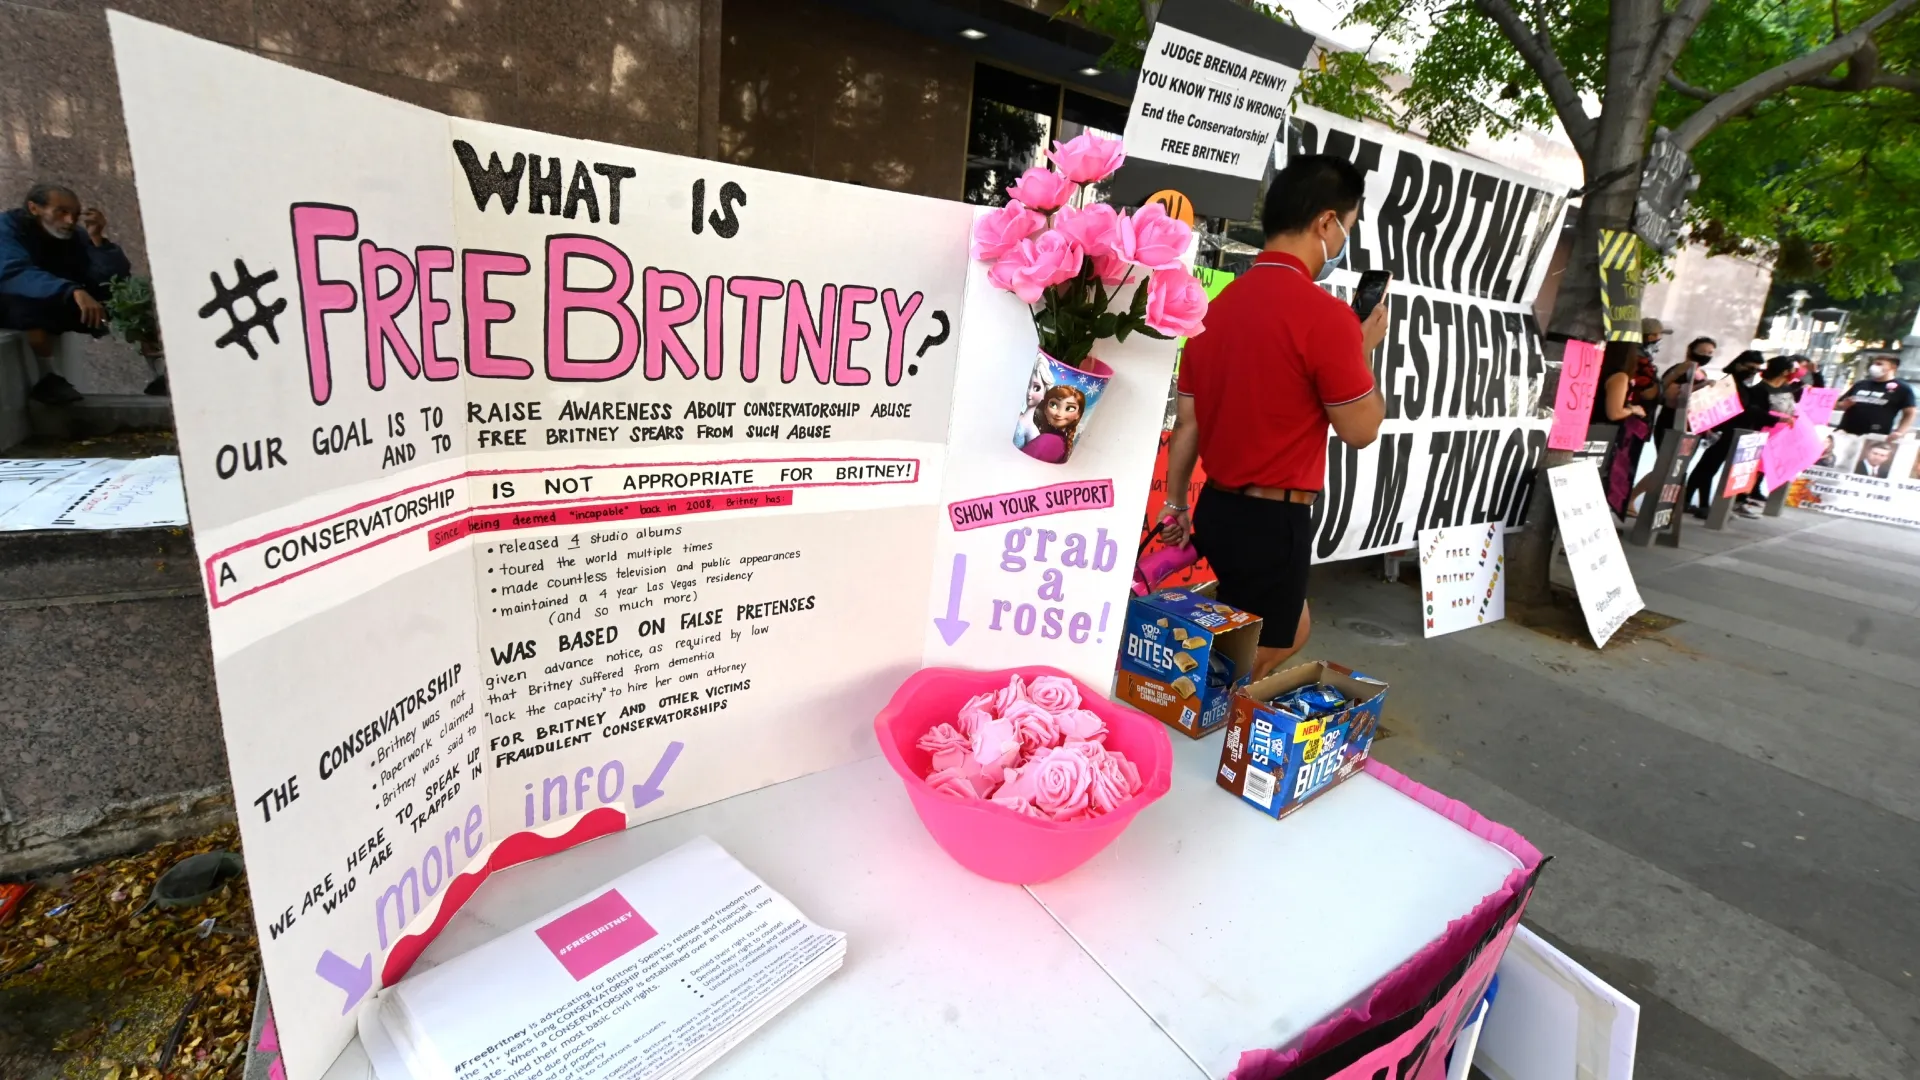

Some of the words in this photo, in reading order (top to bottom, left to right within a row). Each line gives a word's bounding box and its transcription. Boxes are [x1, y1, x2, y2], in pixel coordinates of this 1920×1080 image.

[1161, 42, 1203, 66] JUDGE
[1204, 55, 1247, 80] BRENDA
[1249, 69, 1287, 92] PENNY!
[1142, 69, 1168, 88] YOU
[1169, 77, 1206, 98] KNOW
[1208, 88, 1232, 106] THIS
[1233, 95, 1244, 109] IS
[1246, 98, 1286, 120] WRONG!
[1141, 102, 1164, 120] End
[1166, 110, 1185, 125] the
[1187, 114, 1269, 146] Conservatorship!
[1161, 138, 1190, 156] FREE
[1192, 144, 1240, 165] BRITNEY!
[453, 139, 636, 224] WHAT
[692, 179, 747, 238] IS
[216, 437, 287, 479] OUR
[312, 418, 373, 456] GOAL
[389, 412, 405, 438] IS
[421, 407, 443, 431] TO
[467, 401, 542, 424] RAISE
[558, 401, 672, 421] AWARENESS
[684, 401, 736, 419] ABOUT
[744, 401, 860, 418] CONSERVATORSHIP
[871, 402, 912, 418] ABUSE
[381, 443, 416, 470] AND
[432, 435, 451, 453] TO
[478, 428, 526, 449] FREE
[547, 426, 619, 444] BRITNEY
[629, 426, 683, 442] SPEARS
[697, 425, 733, 440] FROM
[746, 423, 779, 439] SUCH
[787, 425, 831, 439] ABUSE
[954, 504, 993, 525] SHOW
[1000, 495, 1039, 516] YOUR
[1045, 485, 1108, 508] SUPPORT
[1359, 433, 1413, 551] M.
[1413, 427, 1550, 540] TAYLOR
[220, 562, 237, 587] A
[264, 488, 455, 569] CONSERVATORSHIP
[492, 482, 515, 500] IS
[545, 477, 593, 495] NOT
[623, 469, 754, 491] APPROPRIATE
[781, 466, 813, 482] FOR
[836, 464, 912, 480] BRITNEY!
[500, 536, 559, 554] released
[590, 531, 628, 544] studio
[636, 526, 682, 540] albums
[500, 560, 544, 575] toured
[557, 556, 575, 568] the
[586, 552, 617, 565] world
[627, 546, 672, 559] multiple
[683, 541, 712, 553] times
[501, 581, 538, 596] made
[547, 571, 607, 588] countless
[616, 564, 666, 579] television
[676, 561, 693, 572] and
[701, 557, 731, 572] public
[739, 550, 800, 566] appearances
[1000, 527, 1118, 573] grab
[1446, 548, 1470, 558] FREE
[501, 594, 568, 616] maintained
[616, 584, 638, 599] year
[647, 581, 664, 592] Las
[671, 578, 697, 590] Vegas
[706, 570, 753, 585] residency
[1038, 568, 1064, 602] a
[1436, 572, 1475, 583] BRITNEY
[989, 599, 1111, 644] rose!
[1128, 633, 1174, 670] BITES
[253, 775, 300, 822] THE
[319, 663, 461, 780] CONSERVATORSHIP
[491, 640, 537, 665] WAS
[559, 626, 618, 652] BASED
[638, 618, 666, 637] ON
[680, 608, 723, 629] FALSE
[737, 595, 815, 621] PRETENSES
[377, 726, 416, 763] Britney
[422, 710, 440, 730] was
[450, 690, 466, 708] not
[486, 670, 527, 690] given
[544, 656, 594, 674] advance
[606, 647, 643, 663] notice,
[649, 643, 663, 653] as
[675, 632, 721, 649] required
[730, 629, 741, 640] by
[751, 625, 769, 636] law
[1202, 703, 1228, 726] BITES
[381, 738, 433, 785] Paperwork
[440, 704, 474, 738] claimed
[487, 688, 517, 704] that
[528, 677, 573, 695] Britney
[579, 667, 624, 686] suffered
[634, 661, 660, 674] from
[669, 650, 714, 668] dementia
[383, 773, 416, 807] Britney
[422, 754, 440, 774] was
[447, 733, 464, 755] said
[467, 725, 476, 736] to
[485, 708, 516, 725] "lack
[526, 700, 546, 715] the
[554, 687, 607, 710] capacity"
[609, 686, 622, 697] to
[627, 680, 648, 693] hire
[655, 674, 672, 687] her
[678, 671, 698, 683] own
[707, 661, 747, 676] attorney
[1253, 719, 1272, 765] BITES
[1293, 743, 1349, 799] BITES
[270, 906, 296, 940] WE
[301, 873, 334, 915] ARE
[346, 827, 385, 872] HERE
[396, 803, 413, 824] TO
[425, 763, 460, 801] SPEAK
[467, 747, 480, 765] UP
[490, 730, 524, 751] FOR
[536, 711, 607, 740] BRITNEY
[619, 703, 646, 719] AND
[659, 691, 699, 708] OTHER
[706, 679, 751, 698] VICTIMS
[322, 877, 356, 914] WHO
[369, 842, 393, 875] ARE
[411, 783, 461, 834] TRAPPED
[472, 763, 482, 780] IN
[495, 732, 592, 768] FRAUDULENT
[602, 699, 728, 738] CONSERVATORSHIPS
[376, 804, 483, 950] more
[525, 760, 625, 827] info
[559, 911, 633, 956] #FREEBRITNEY
[454, 1028, 526, 1073] #FreeBritney
[529, 1021, 537, 1029] is
[540, 991, 591, 1024] advocating
[592, 982, 605, 992] for
[606, 963, 639, 983] Britney
[638, 944, 673, 964] Spears's
[673, 925, 701, 944] release
[701, 914, 715, 926] and
[715, 896, 745, 916] freedom
[743, 884, 762, 898] from
